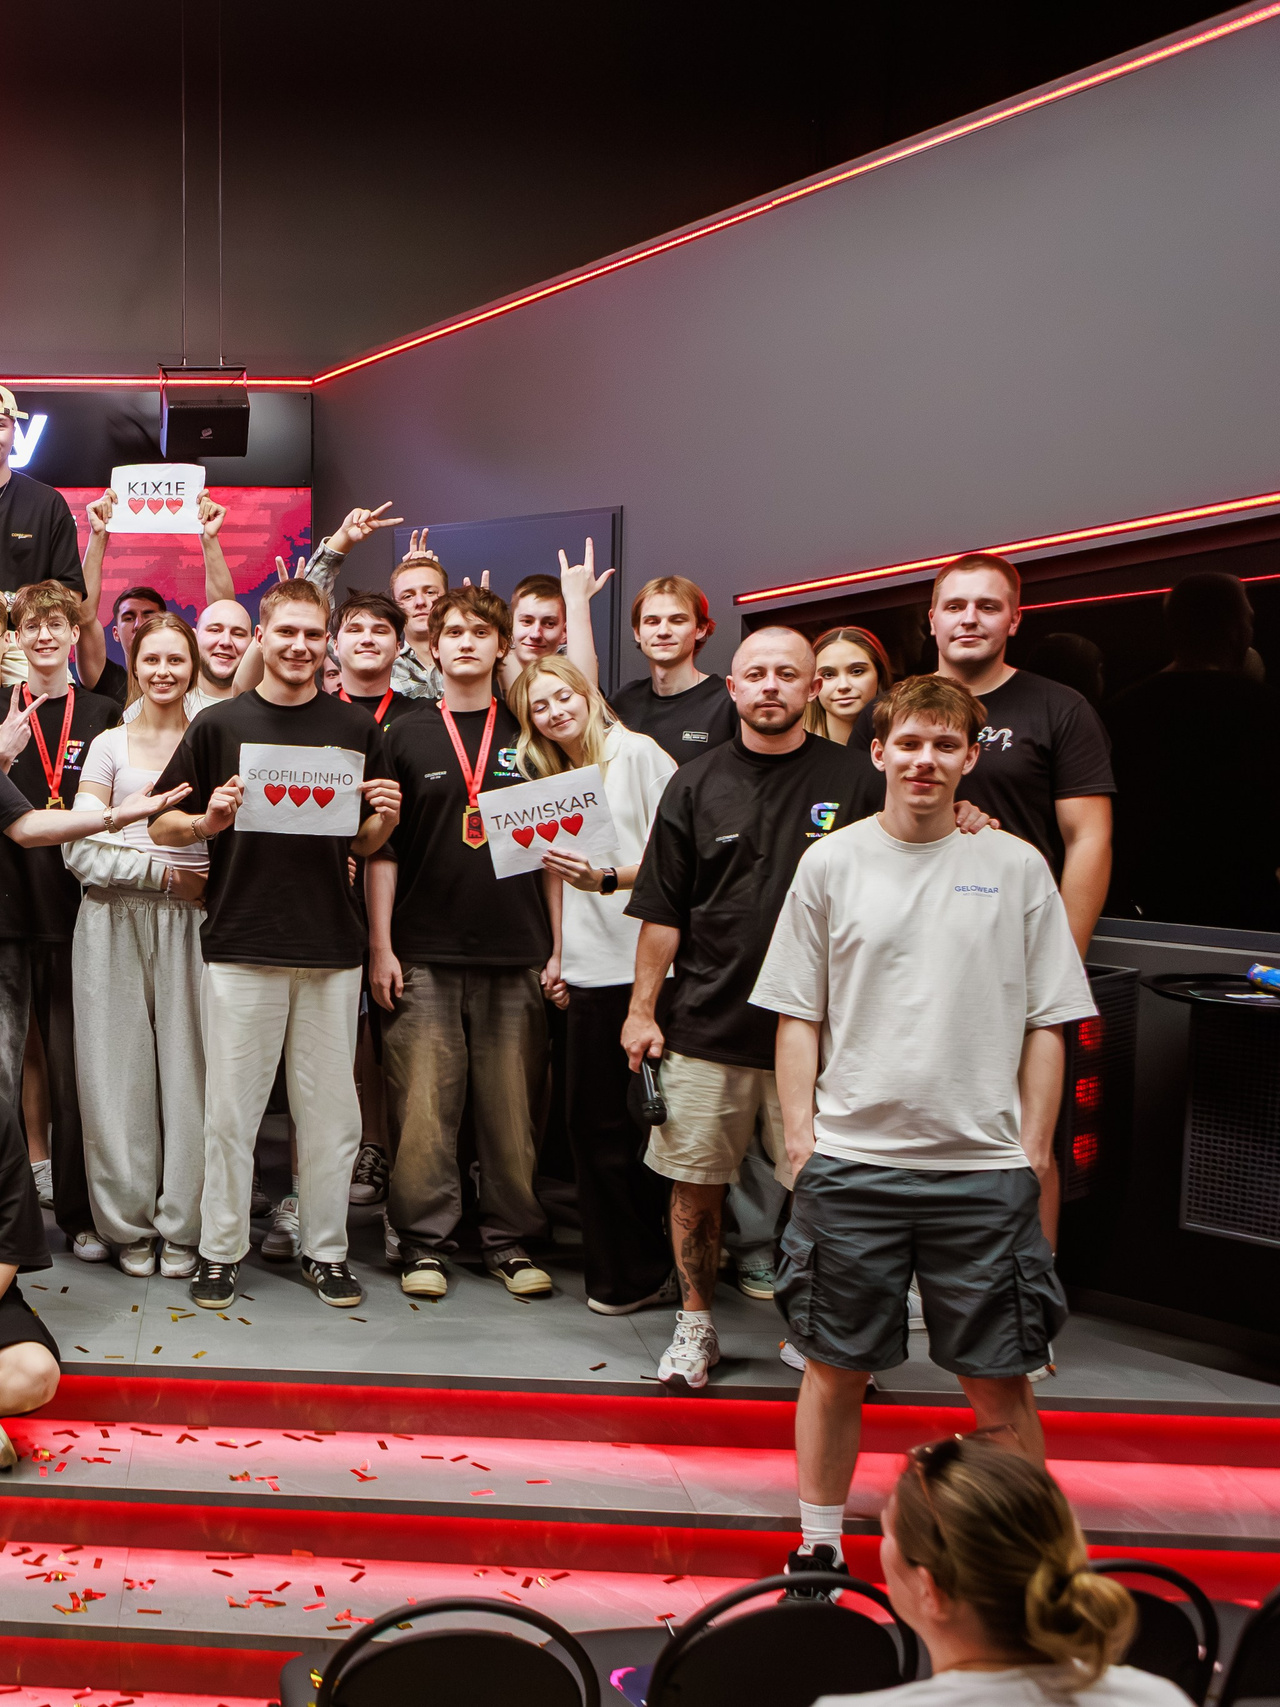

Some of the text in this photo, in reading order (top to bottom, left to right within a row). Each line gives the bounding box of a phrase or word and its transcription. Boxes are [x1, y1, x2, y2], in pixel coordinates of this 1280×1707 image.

[127, 481, 186, 496] K1X1E
[247, 768, 354, 786] SCOFILDINHO
[490, 791, 598, 831] TAWISKAR
[954, 884, 999, 894] GELOWEAR
